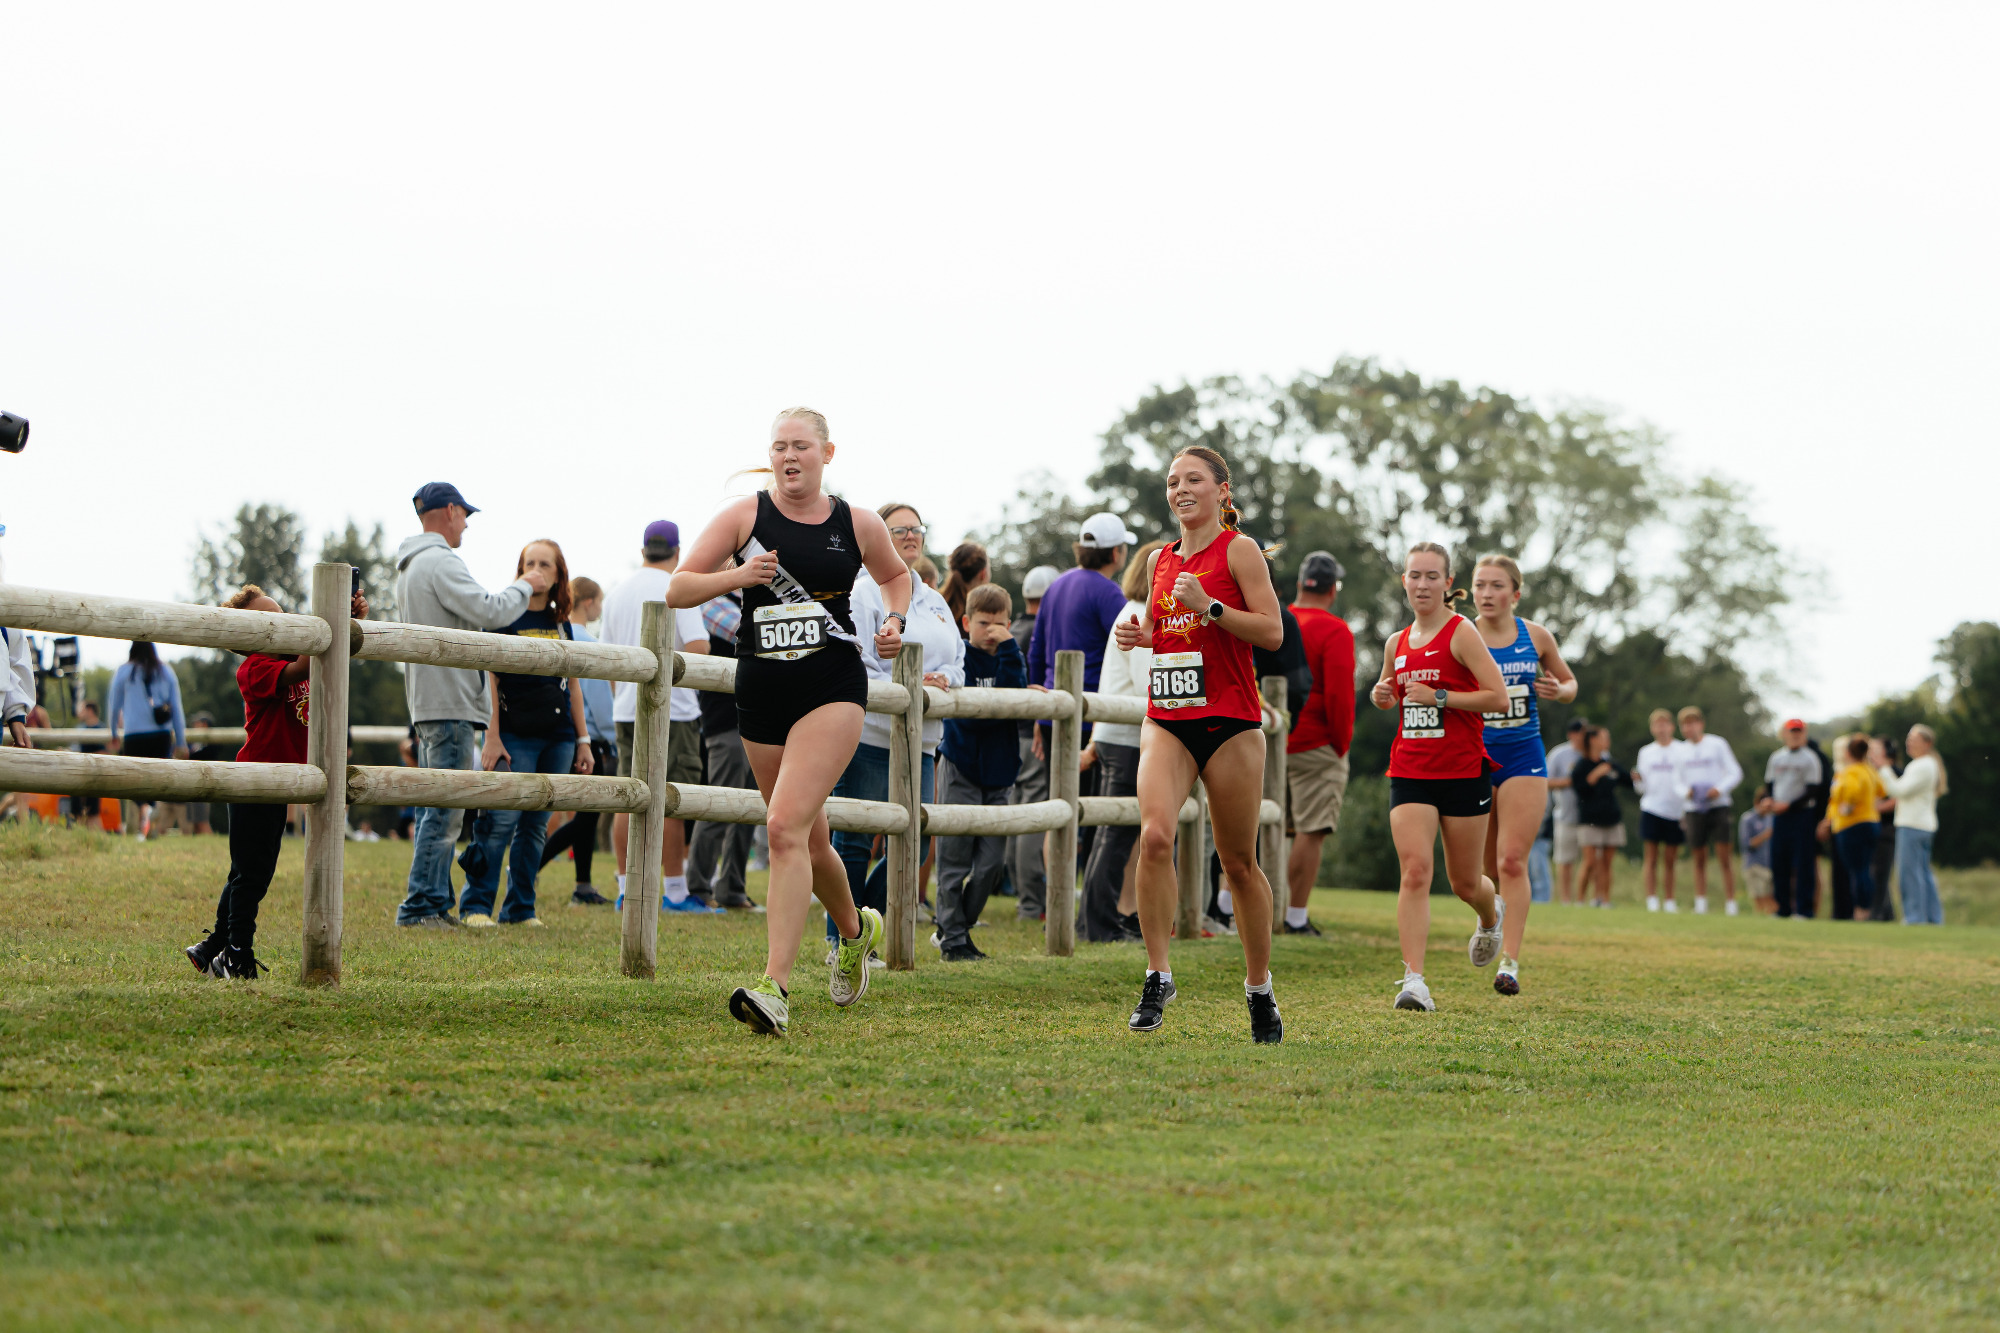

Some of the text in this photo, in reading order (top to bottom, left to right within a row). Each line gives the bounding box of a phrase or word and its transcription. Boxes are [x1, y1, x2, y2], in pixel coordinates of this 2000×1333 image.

[760, 619, 820, 649] 5029
[1162, 612, 1198, 632] UMSL
[1153, 669, 1199, 696] 5168
[1404, 707, 1439, 728] 5053
